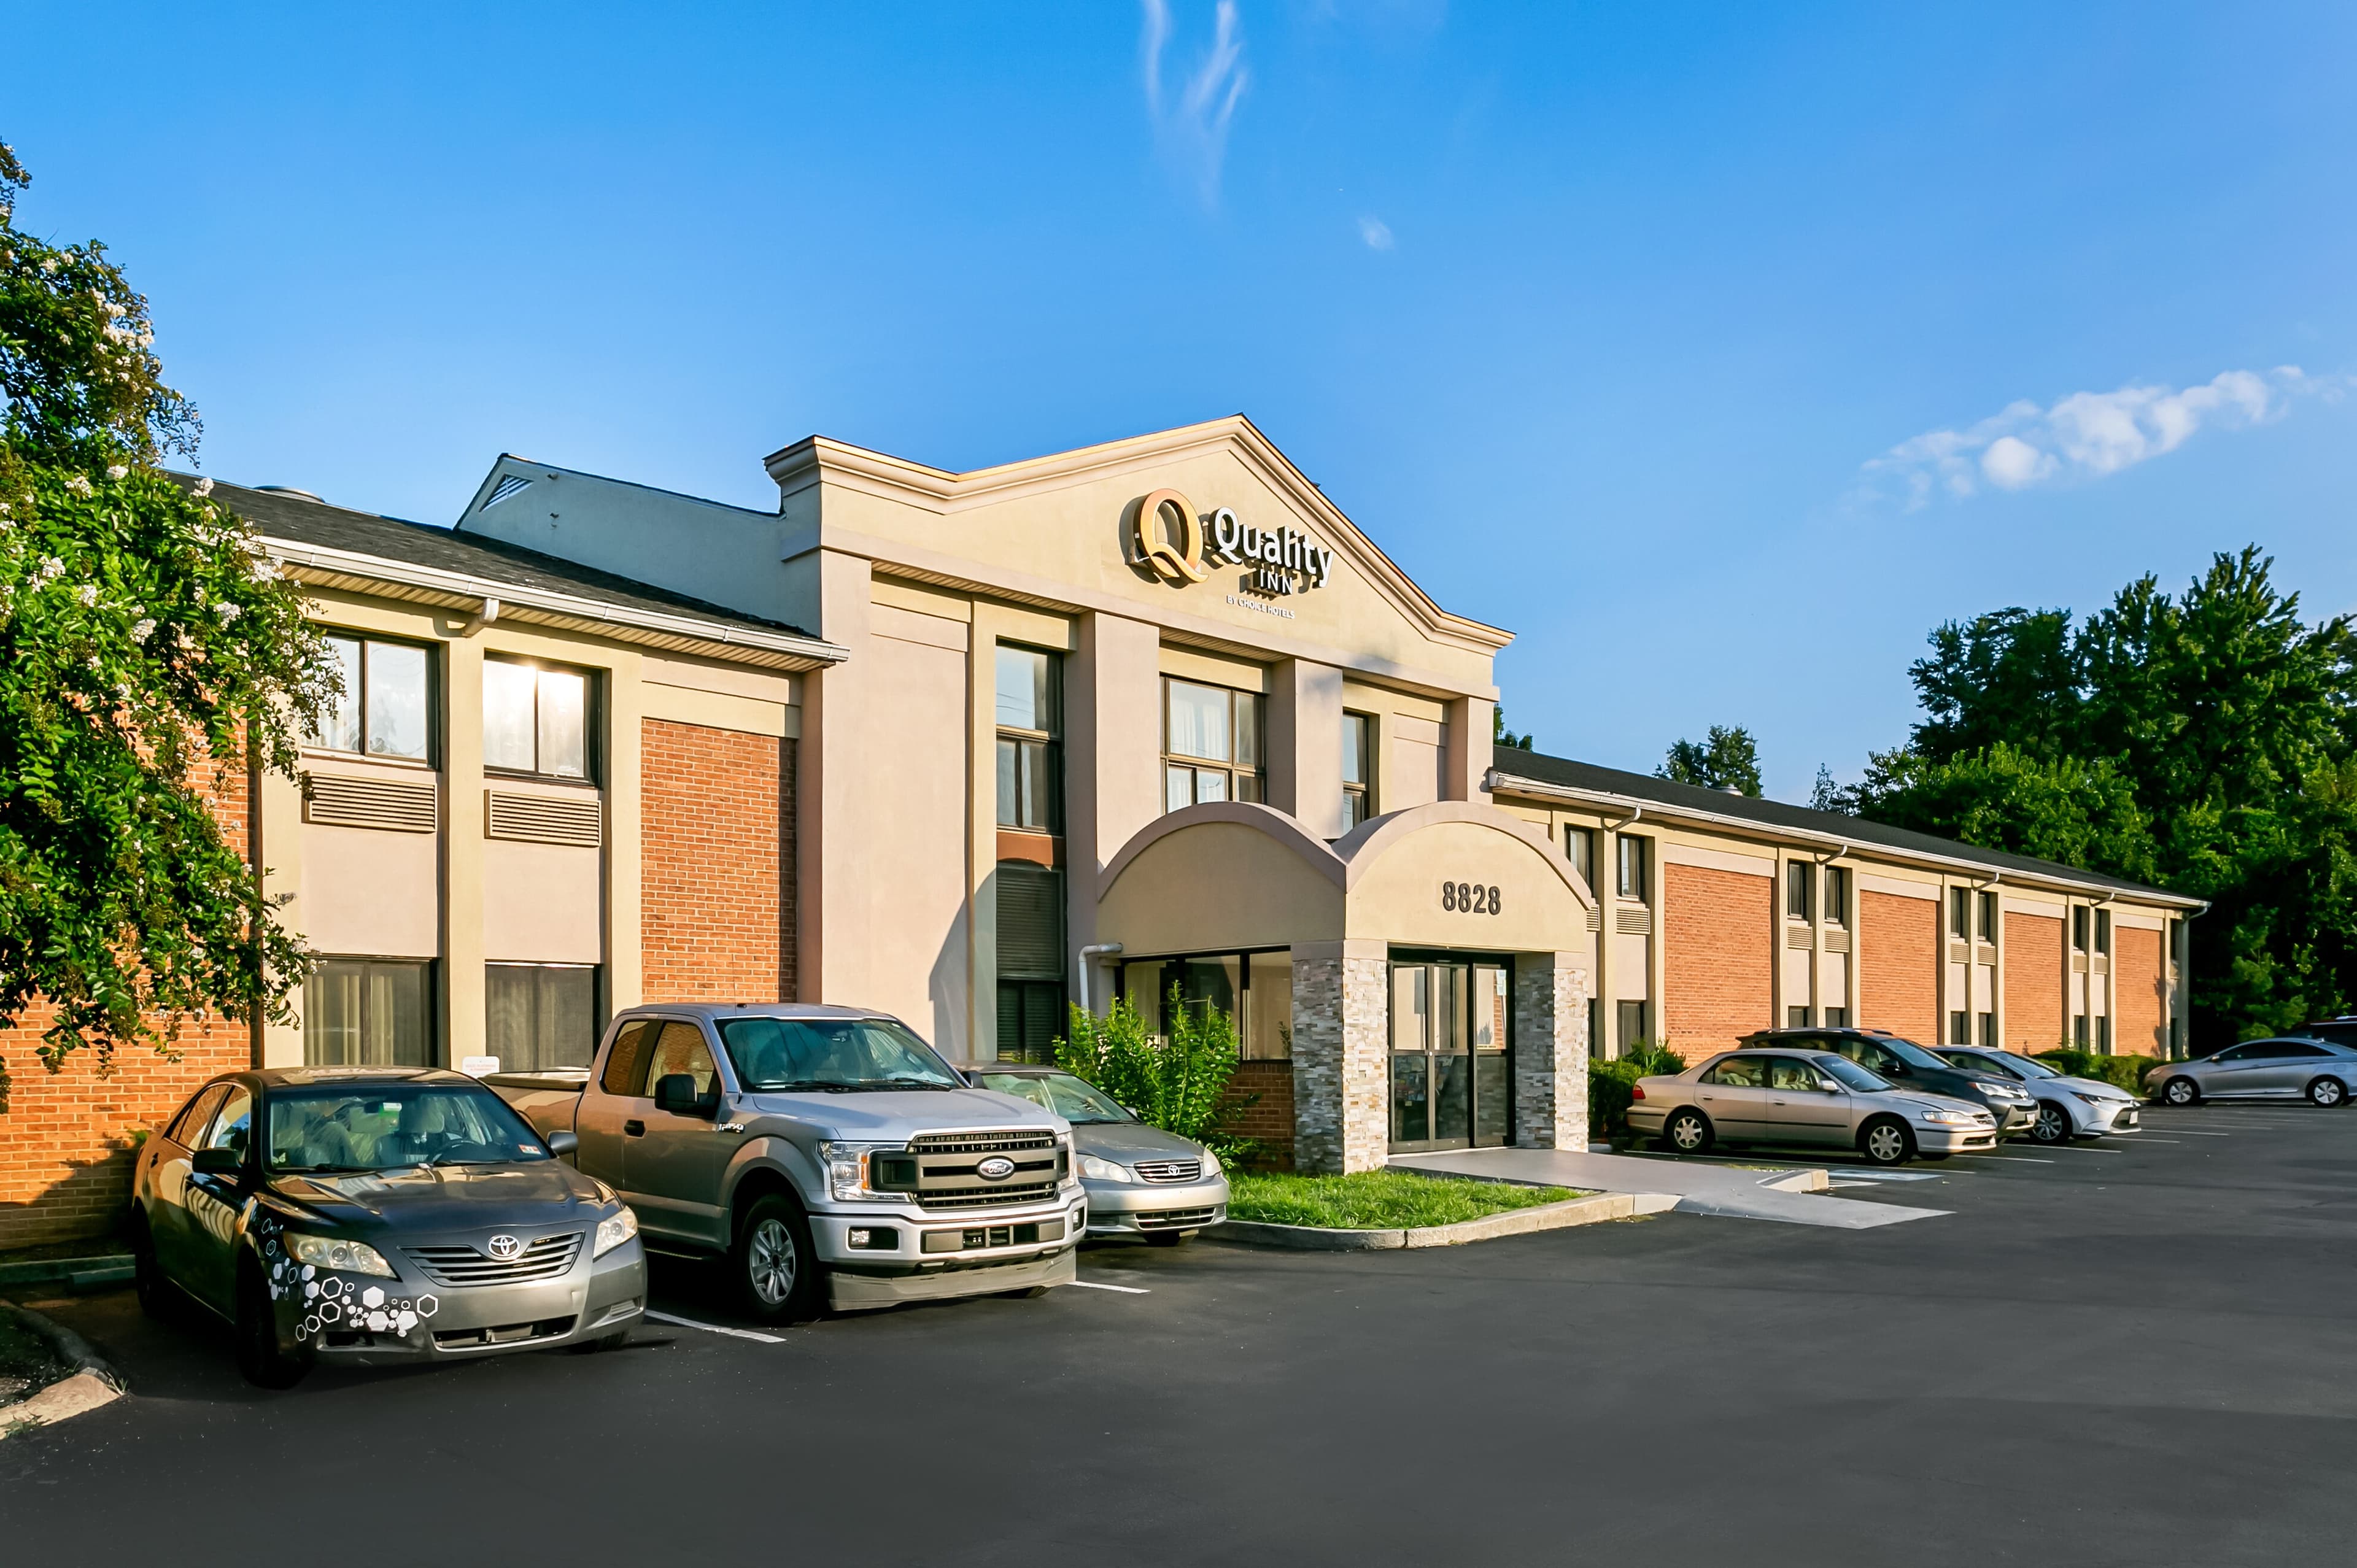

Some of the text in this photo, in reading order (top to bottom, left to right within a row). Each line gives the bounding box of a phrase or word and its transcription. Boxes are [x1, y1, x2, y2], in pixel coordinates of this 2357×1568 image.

[1138, 488, 1209, 583] Q
[1213, 506, 1334, 588] Quality
[1258, 569, 1293, 595] INN
[1226, 595, 1295, 619] BY CHOICE HOTELS
[1442, 881, 1501, 916] 8828
[986, 1162, 1007, 1173] Ford
